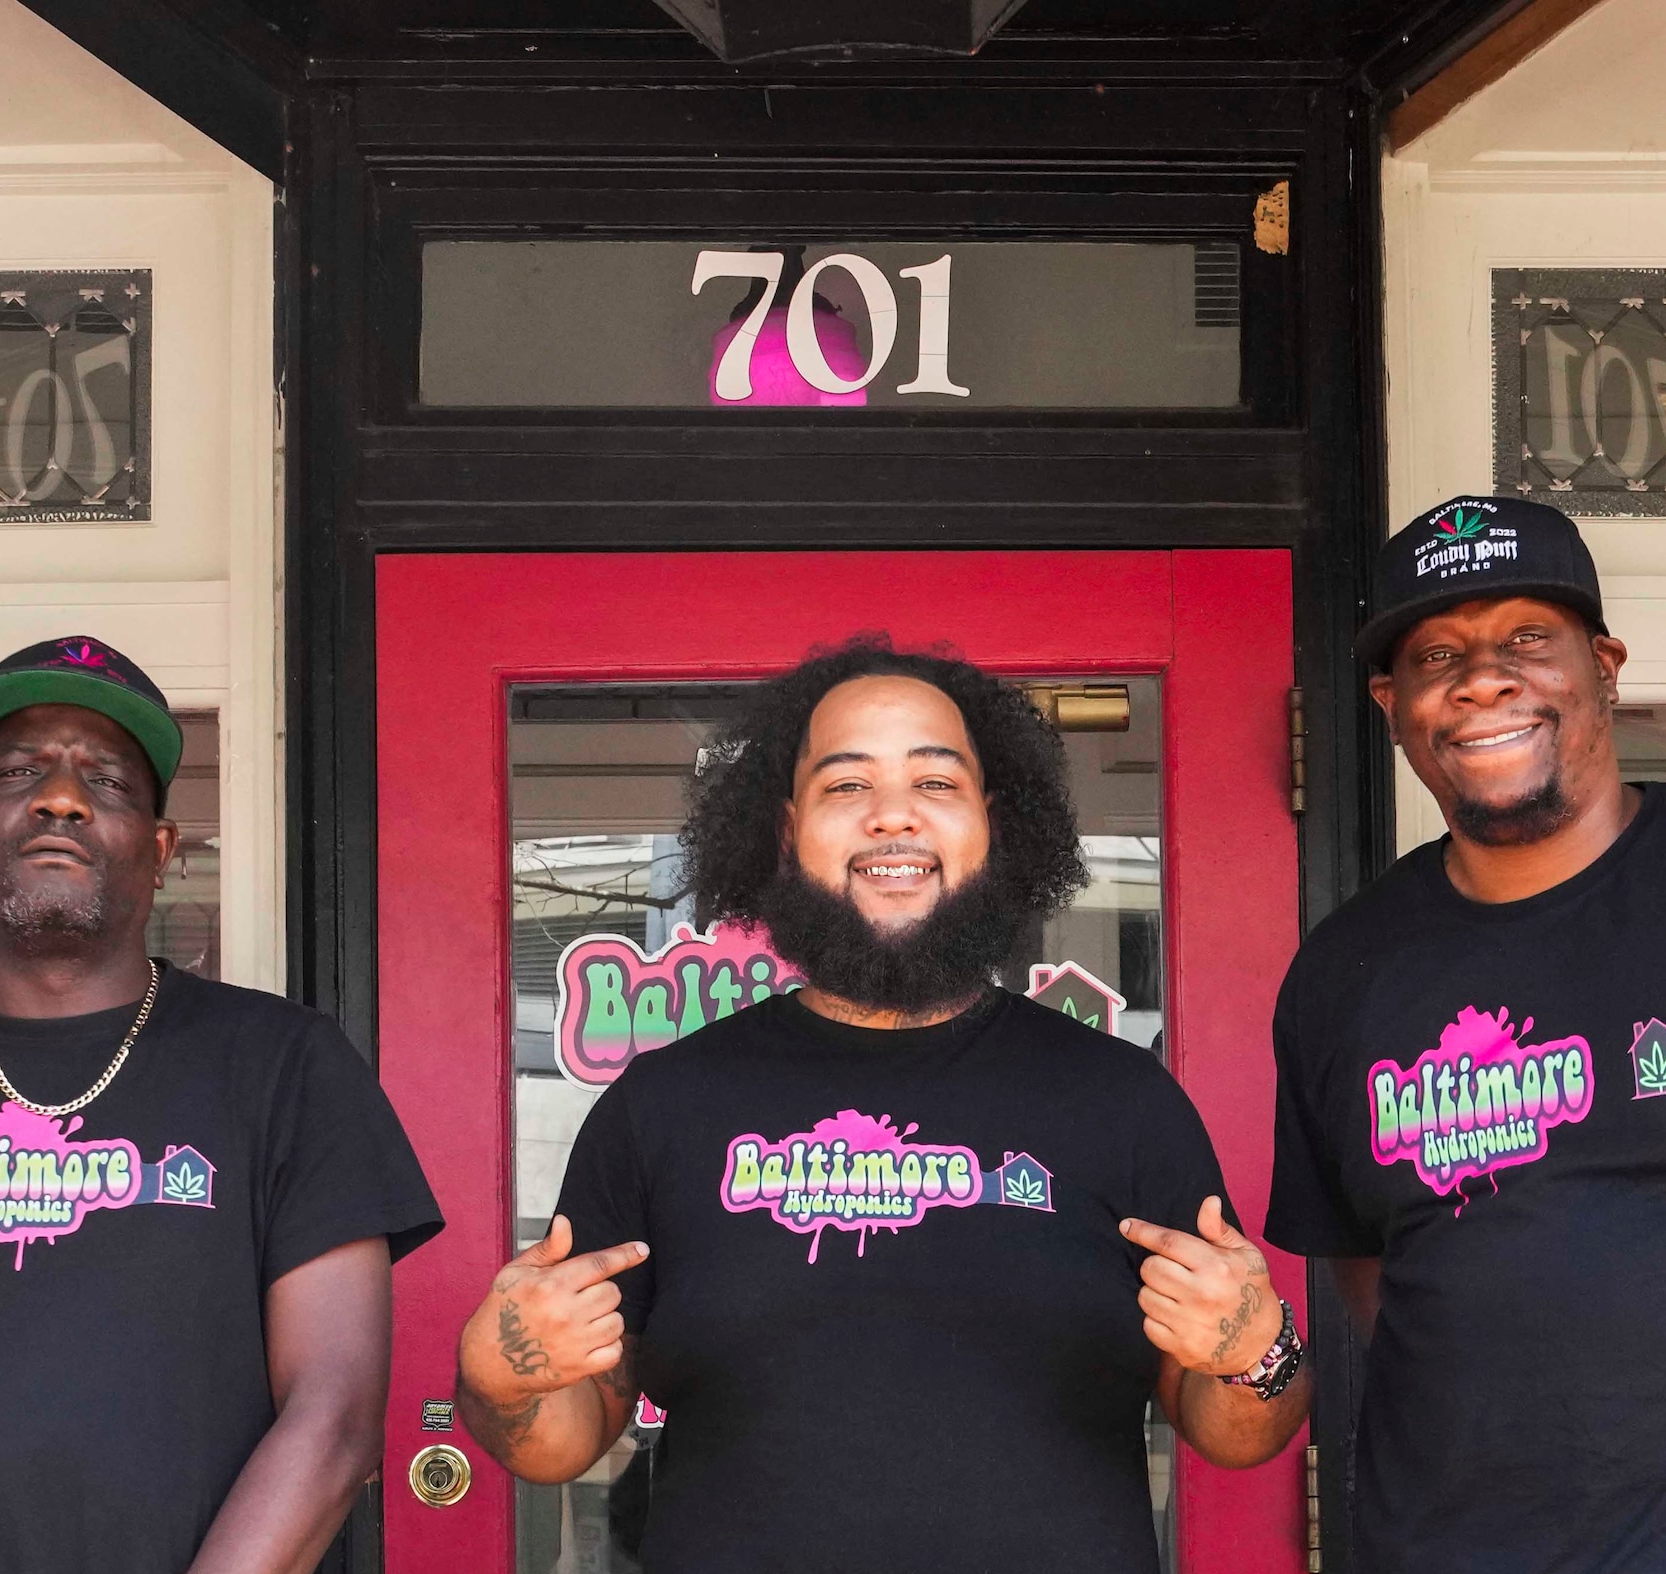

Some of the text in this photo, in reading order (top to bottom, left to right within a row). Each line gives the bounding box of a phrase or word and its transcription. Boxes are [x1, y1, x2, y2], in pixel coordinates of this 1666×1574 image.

[691, 250, 972, 401] 701
[1489, 528, 1517, 537] 2022
[1441, 561, 1491, 578] BRAND
[1374, 1049, 1585, 1151] Baltimore
[731, 1140, 972, 1202] Baltimore
[1423, 1114, 1537, 1177] Hydroponics
[784, 1189, 912, 1222] Hydroponics
